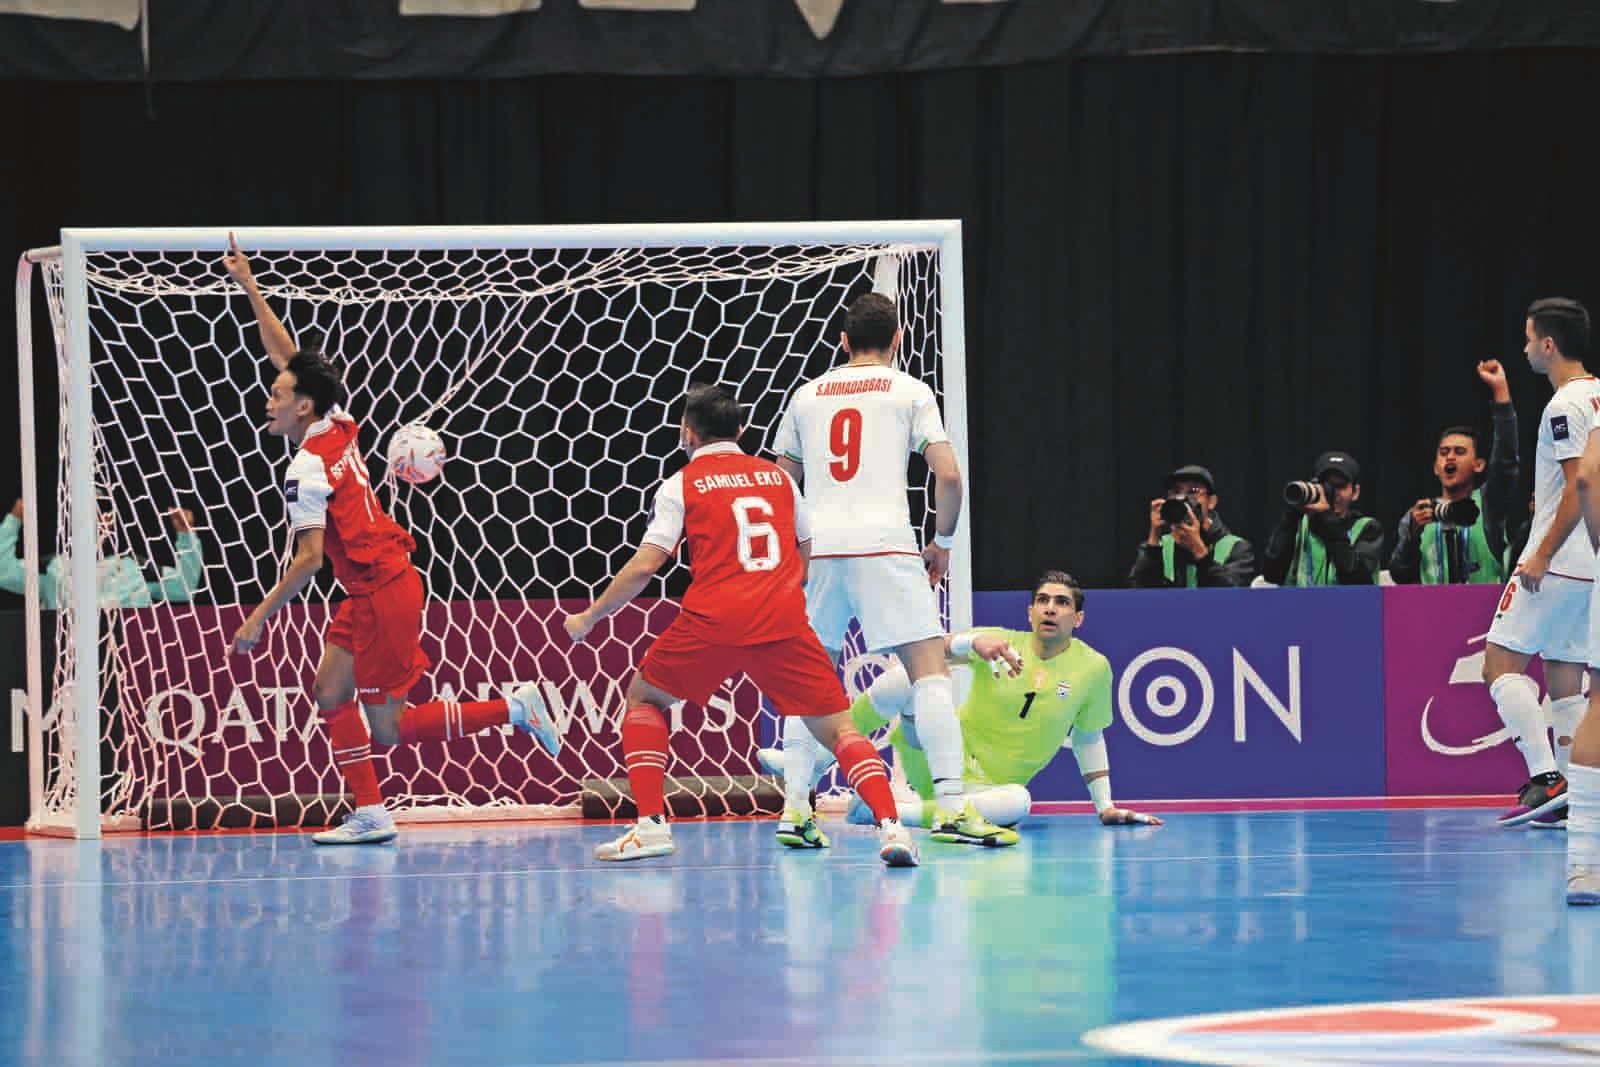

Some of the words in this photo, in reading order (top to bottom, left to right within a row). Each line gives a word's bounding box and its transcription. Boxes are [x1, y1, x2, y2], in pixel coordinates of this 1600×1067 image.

[829, 407, 862, 482] 9
[694, 472, 754, 494] SAMUEL
[753, 470, 783, 487] EKO
[731, 496, 781, 572] 6
[1500, 582, 1516, 612] 6
[1019, 691, 1036, 719] 1
